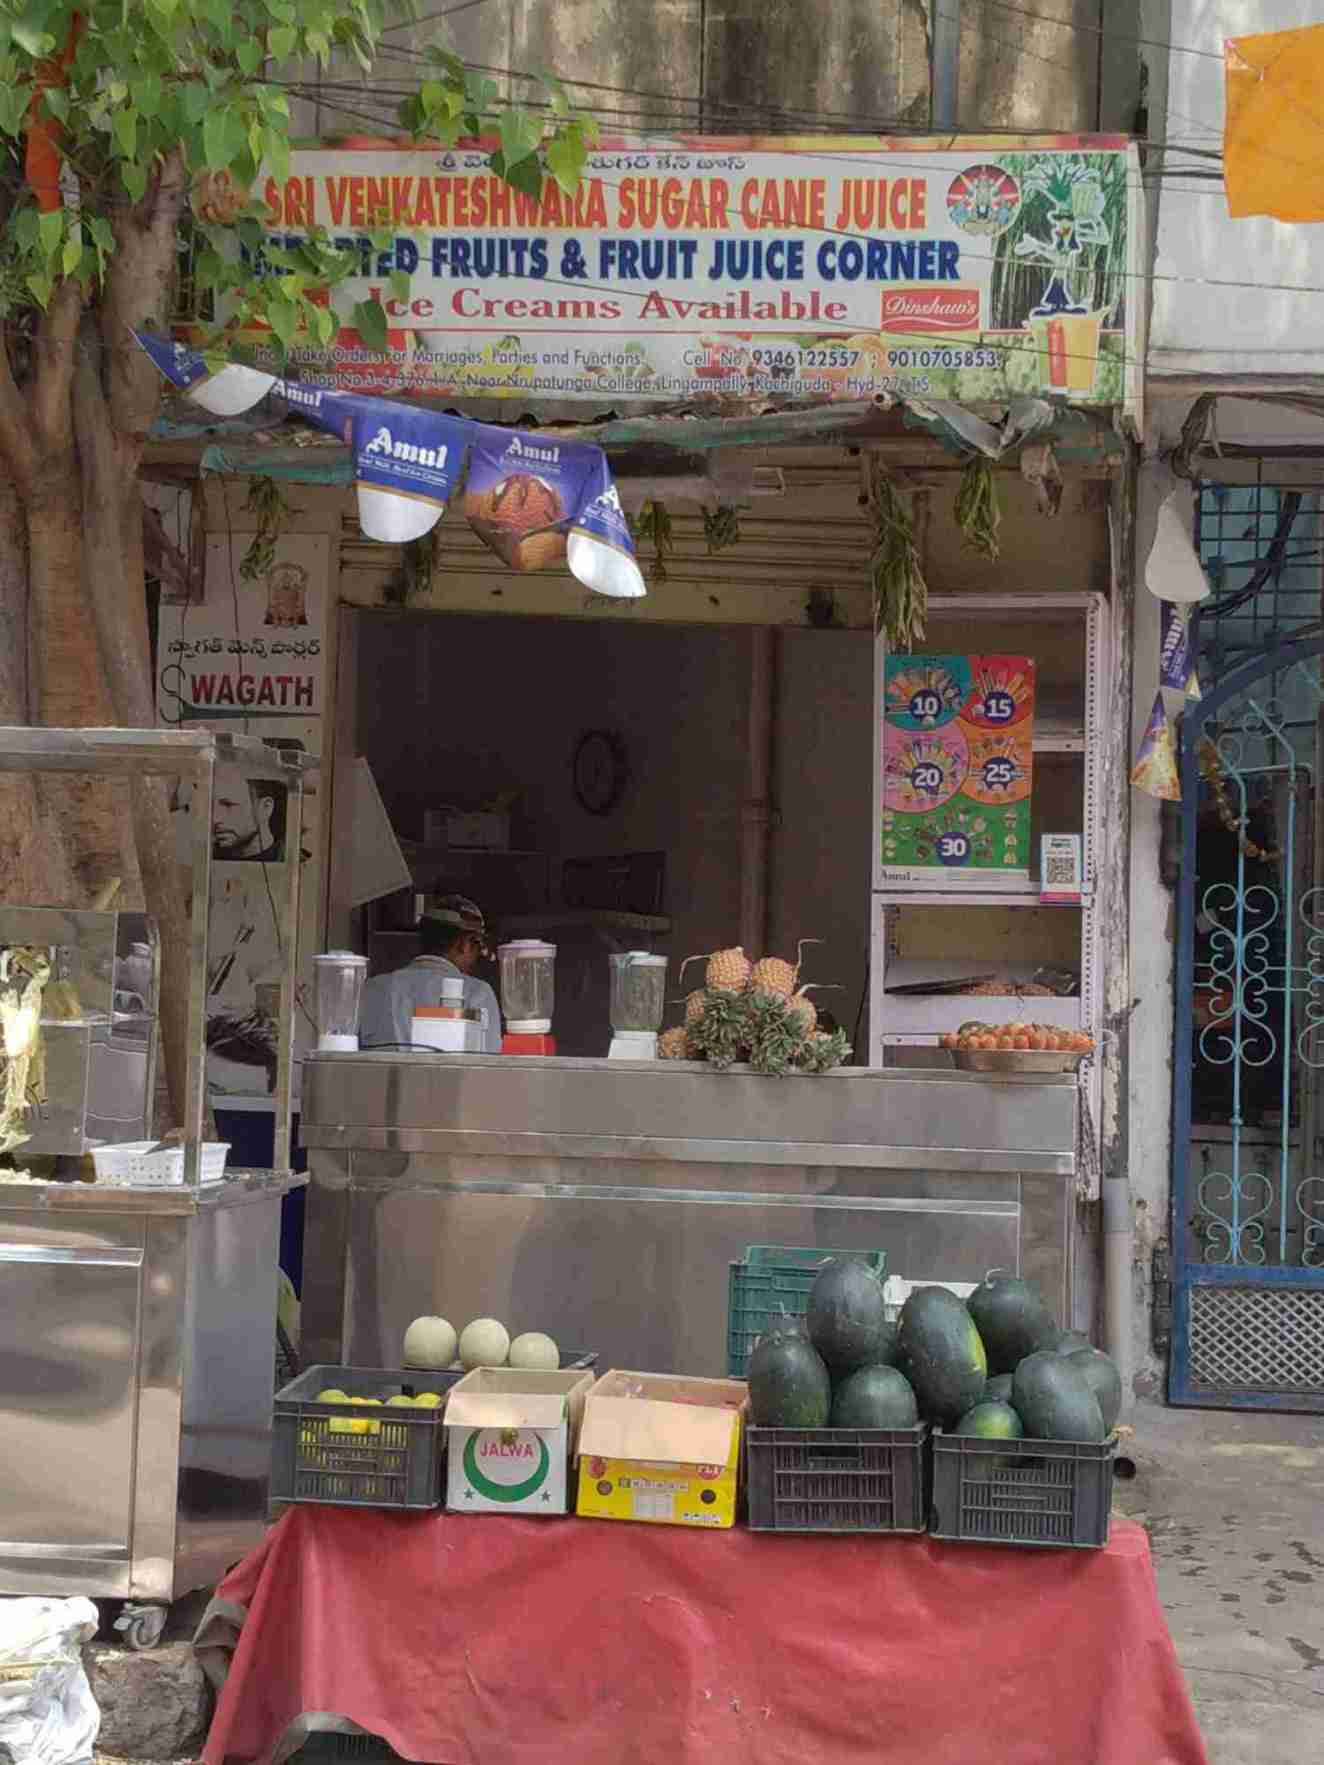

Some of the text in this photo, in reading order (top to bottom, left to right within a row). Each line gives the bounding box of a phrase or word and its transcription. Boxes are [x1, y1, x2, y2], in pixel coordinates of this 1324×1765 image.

[264, 176, 314, 228] SRI
[617, 177, 729, 230] SUGAR
[740, 178, 826, 230] CANE
[836, 178, 928, 230] JUICE
[432, 237, 548, 279] FRUITS
[560, 237, 588, 279] &
[600, 239, 697, 280] FRUIT
[708, 239, 804, 280] JUICE
[816, 240, 960, 280] CORNER
[452, 287, 622, 319] Creams
[639, 290, 849, 321] Available
[541, 350, 569, 366] and
[574, 350, 641, 368] Functions
[752, 350, 859, 368] 9346122557
[272, 379, 322, 407] Amul
[365, 427, 448, 469] Amul
[505, 437, 561, 463] Amul
[914, 698, 1011, 717] 10 15
[915, 764, 1010, 786] 20 25
[941, 838, 966, 856] 30
[480, 1441, 534, 1456] JALWA
